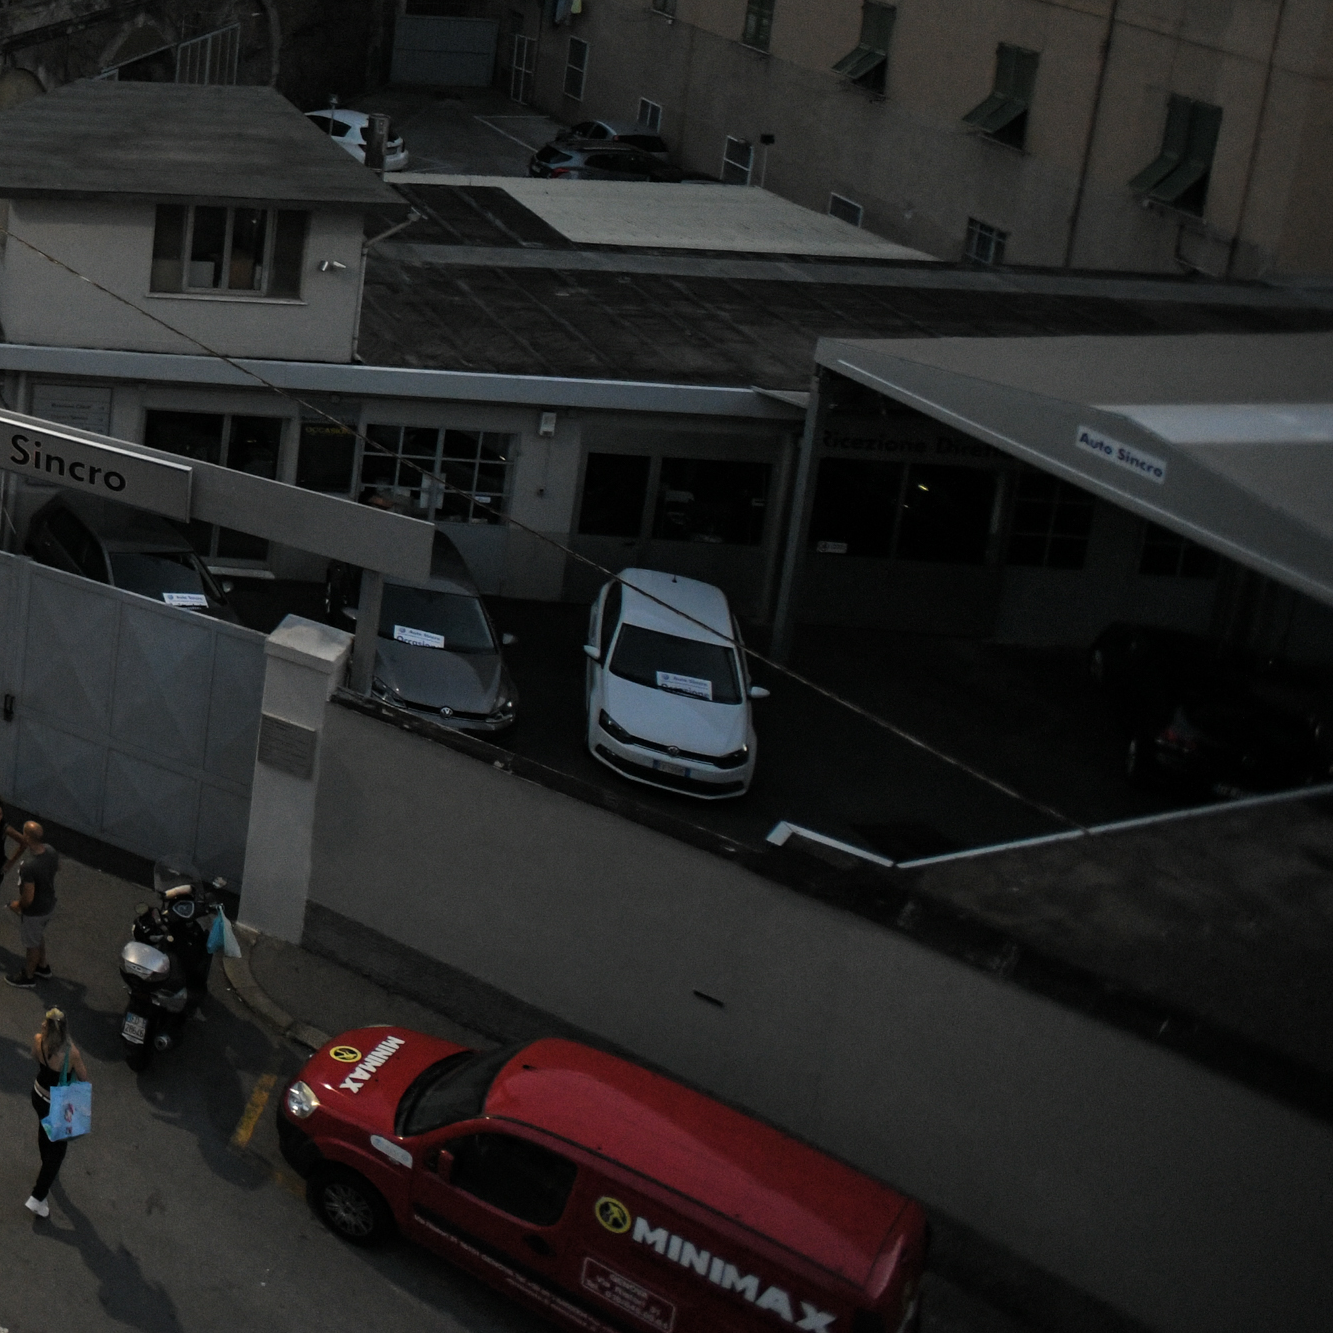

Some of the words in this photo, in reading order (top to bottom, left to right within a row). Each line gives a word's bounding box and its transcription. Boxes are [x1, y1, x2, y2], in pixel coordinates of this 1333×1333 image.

[10, 434, 126, 492] Sincro
[1079, 432, 1112, 455] Auto
[1118, 448, 1163, 477] Sincro
[339, 1035, 406, 1094] MINIMAX
[633, 1216, 837, 1333] MINIMAX
